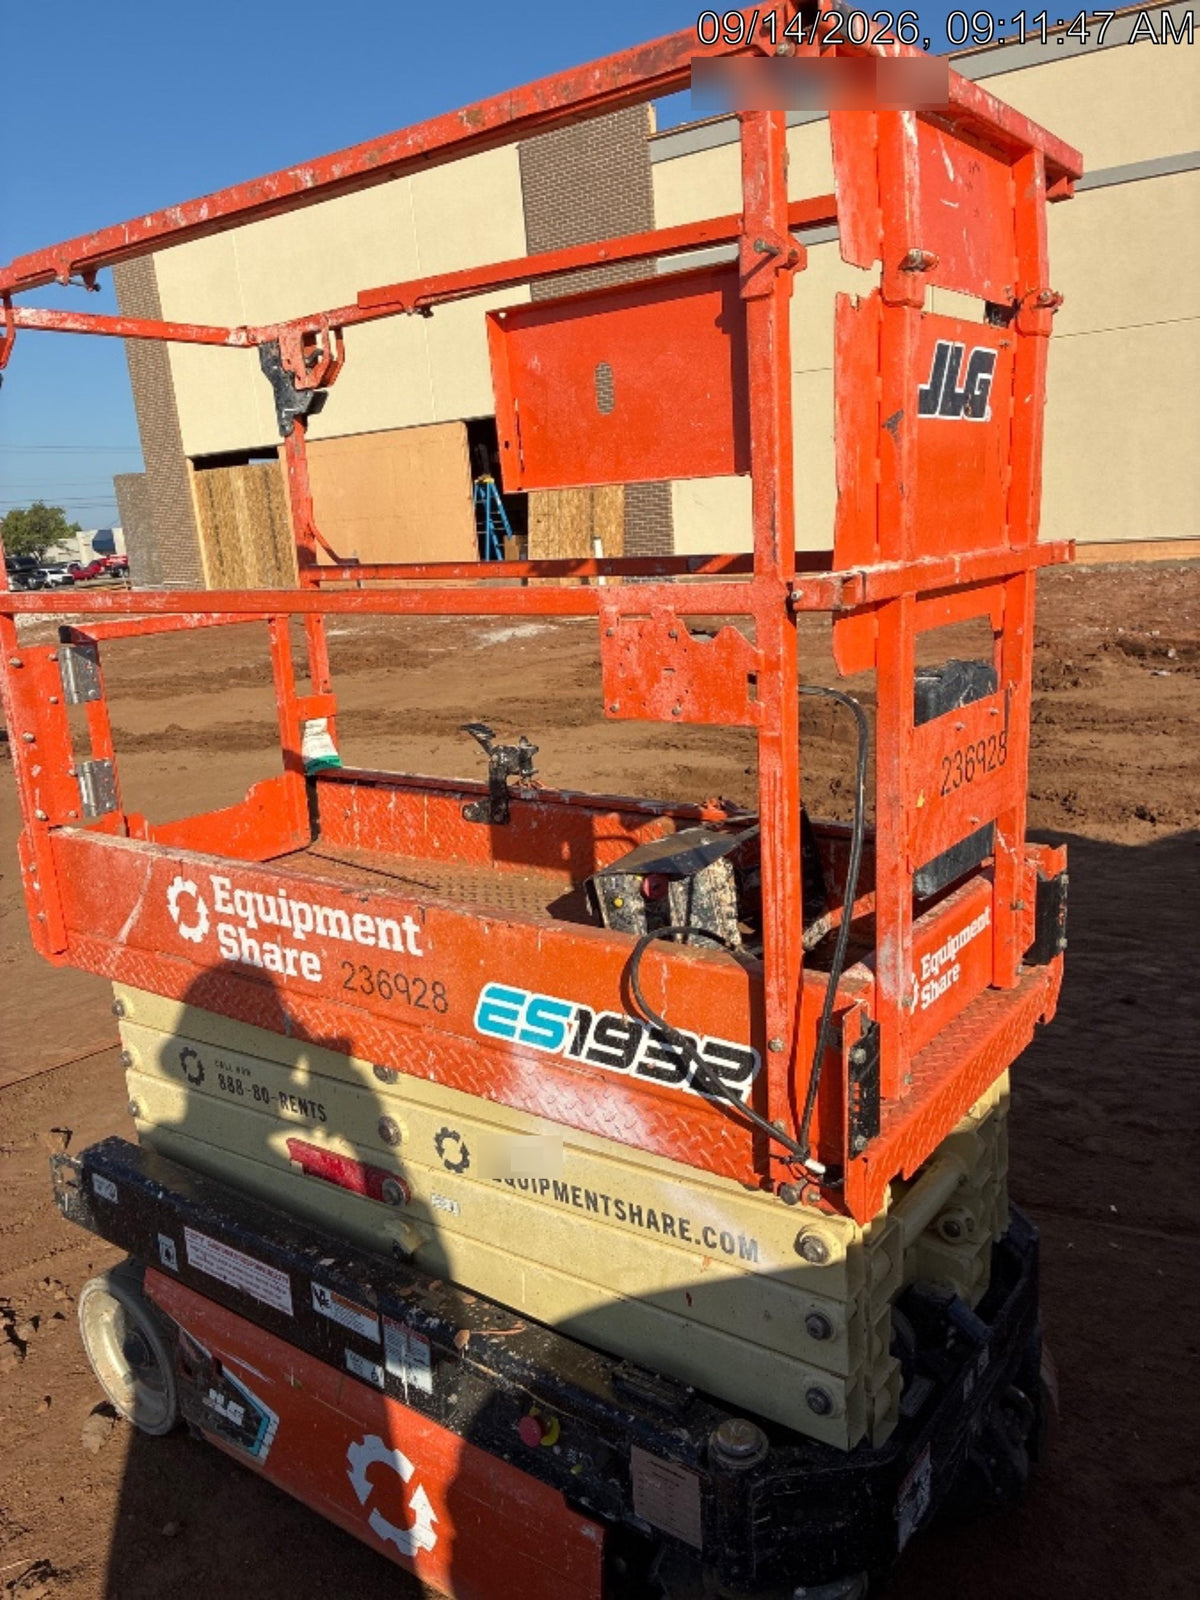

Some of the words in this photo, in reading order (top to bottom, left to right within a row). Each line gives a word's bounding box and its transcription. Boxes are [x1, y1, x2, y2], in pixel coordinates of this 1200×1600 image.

[917, 339, 998, 421] JLG
[941, 730, 1007, 796] 236928
[209, 874, 424, 956] Equipment
[216, 923, 323, 982] Share
[921, 905, 990, 982] Equipment
[341, 961, 449, 1013] 236928
[921, 963, 960, 1010] Share
[475, 983, 760, 1104] ES1932
[492, 1178, 759, 1263] UIPMENTSHARE.COM
